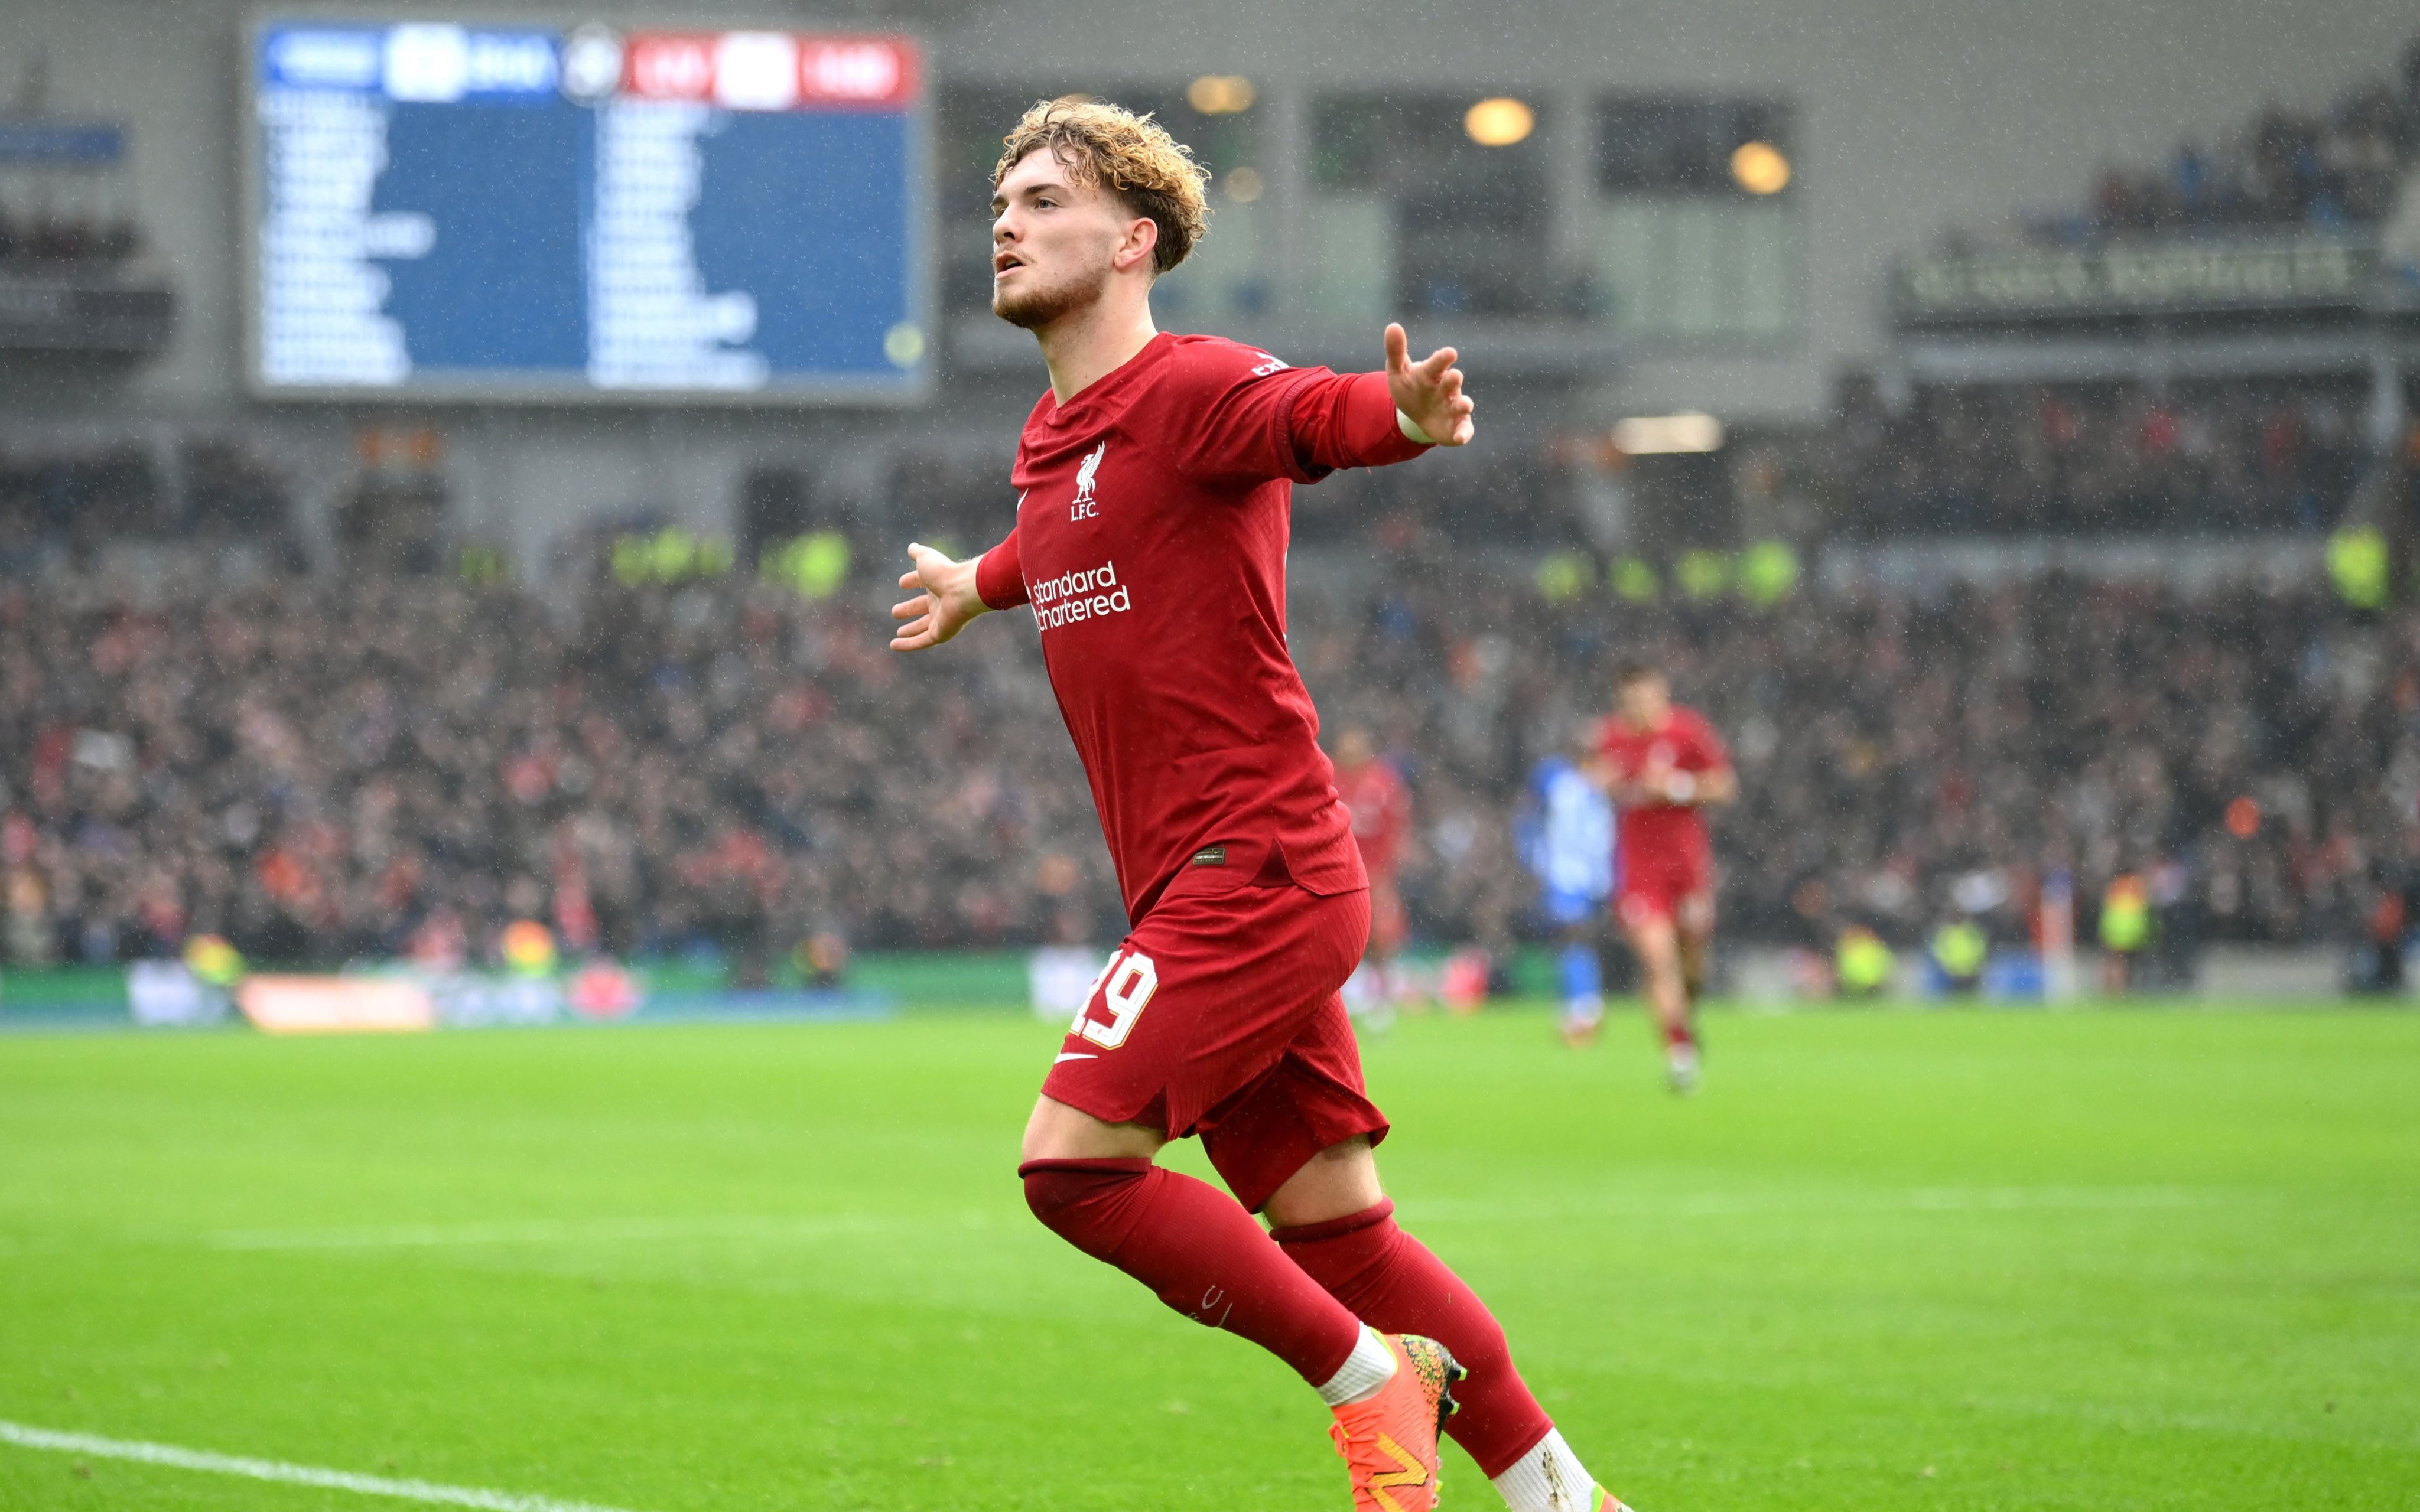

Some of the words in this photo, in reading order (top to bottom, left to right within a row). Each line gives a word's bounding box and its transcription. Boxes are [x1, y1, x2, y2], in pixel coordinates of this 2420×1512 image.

[1071, 502, 1099, 522] L.F.C.
[1033, 561, 1117, 605] standard
[1038, 585, 1131, 631] chartered
